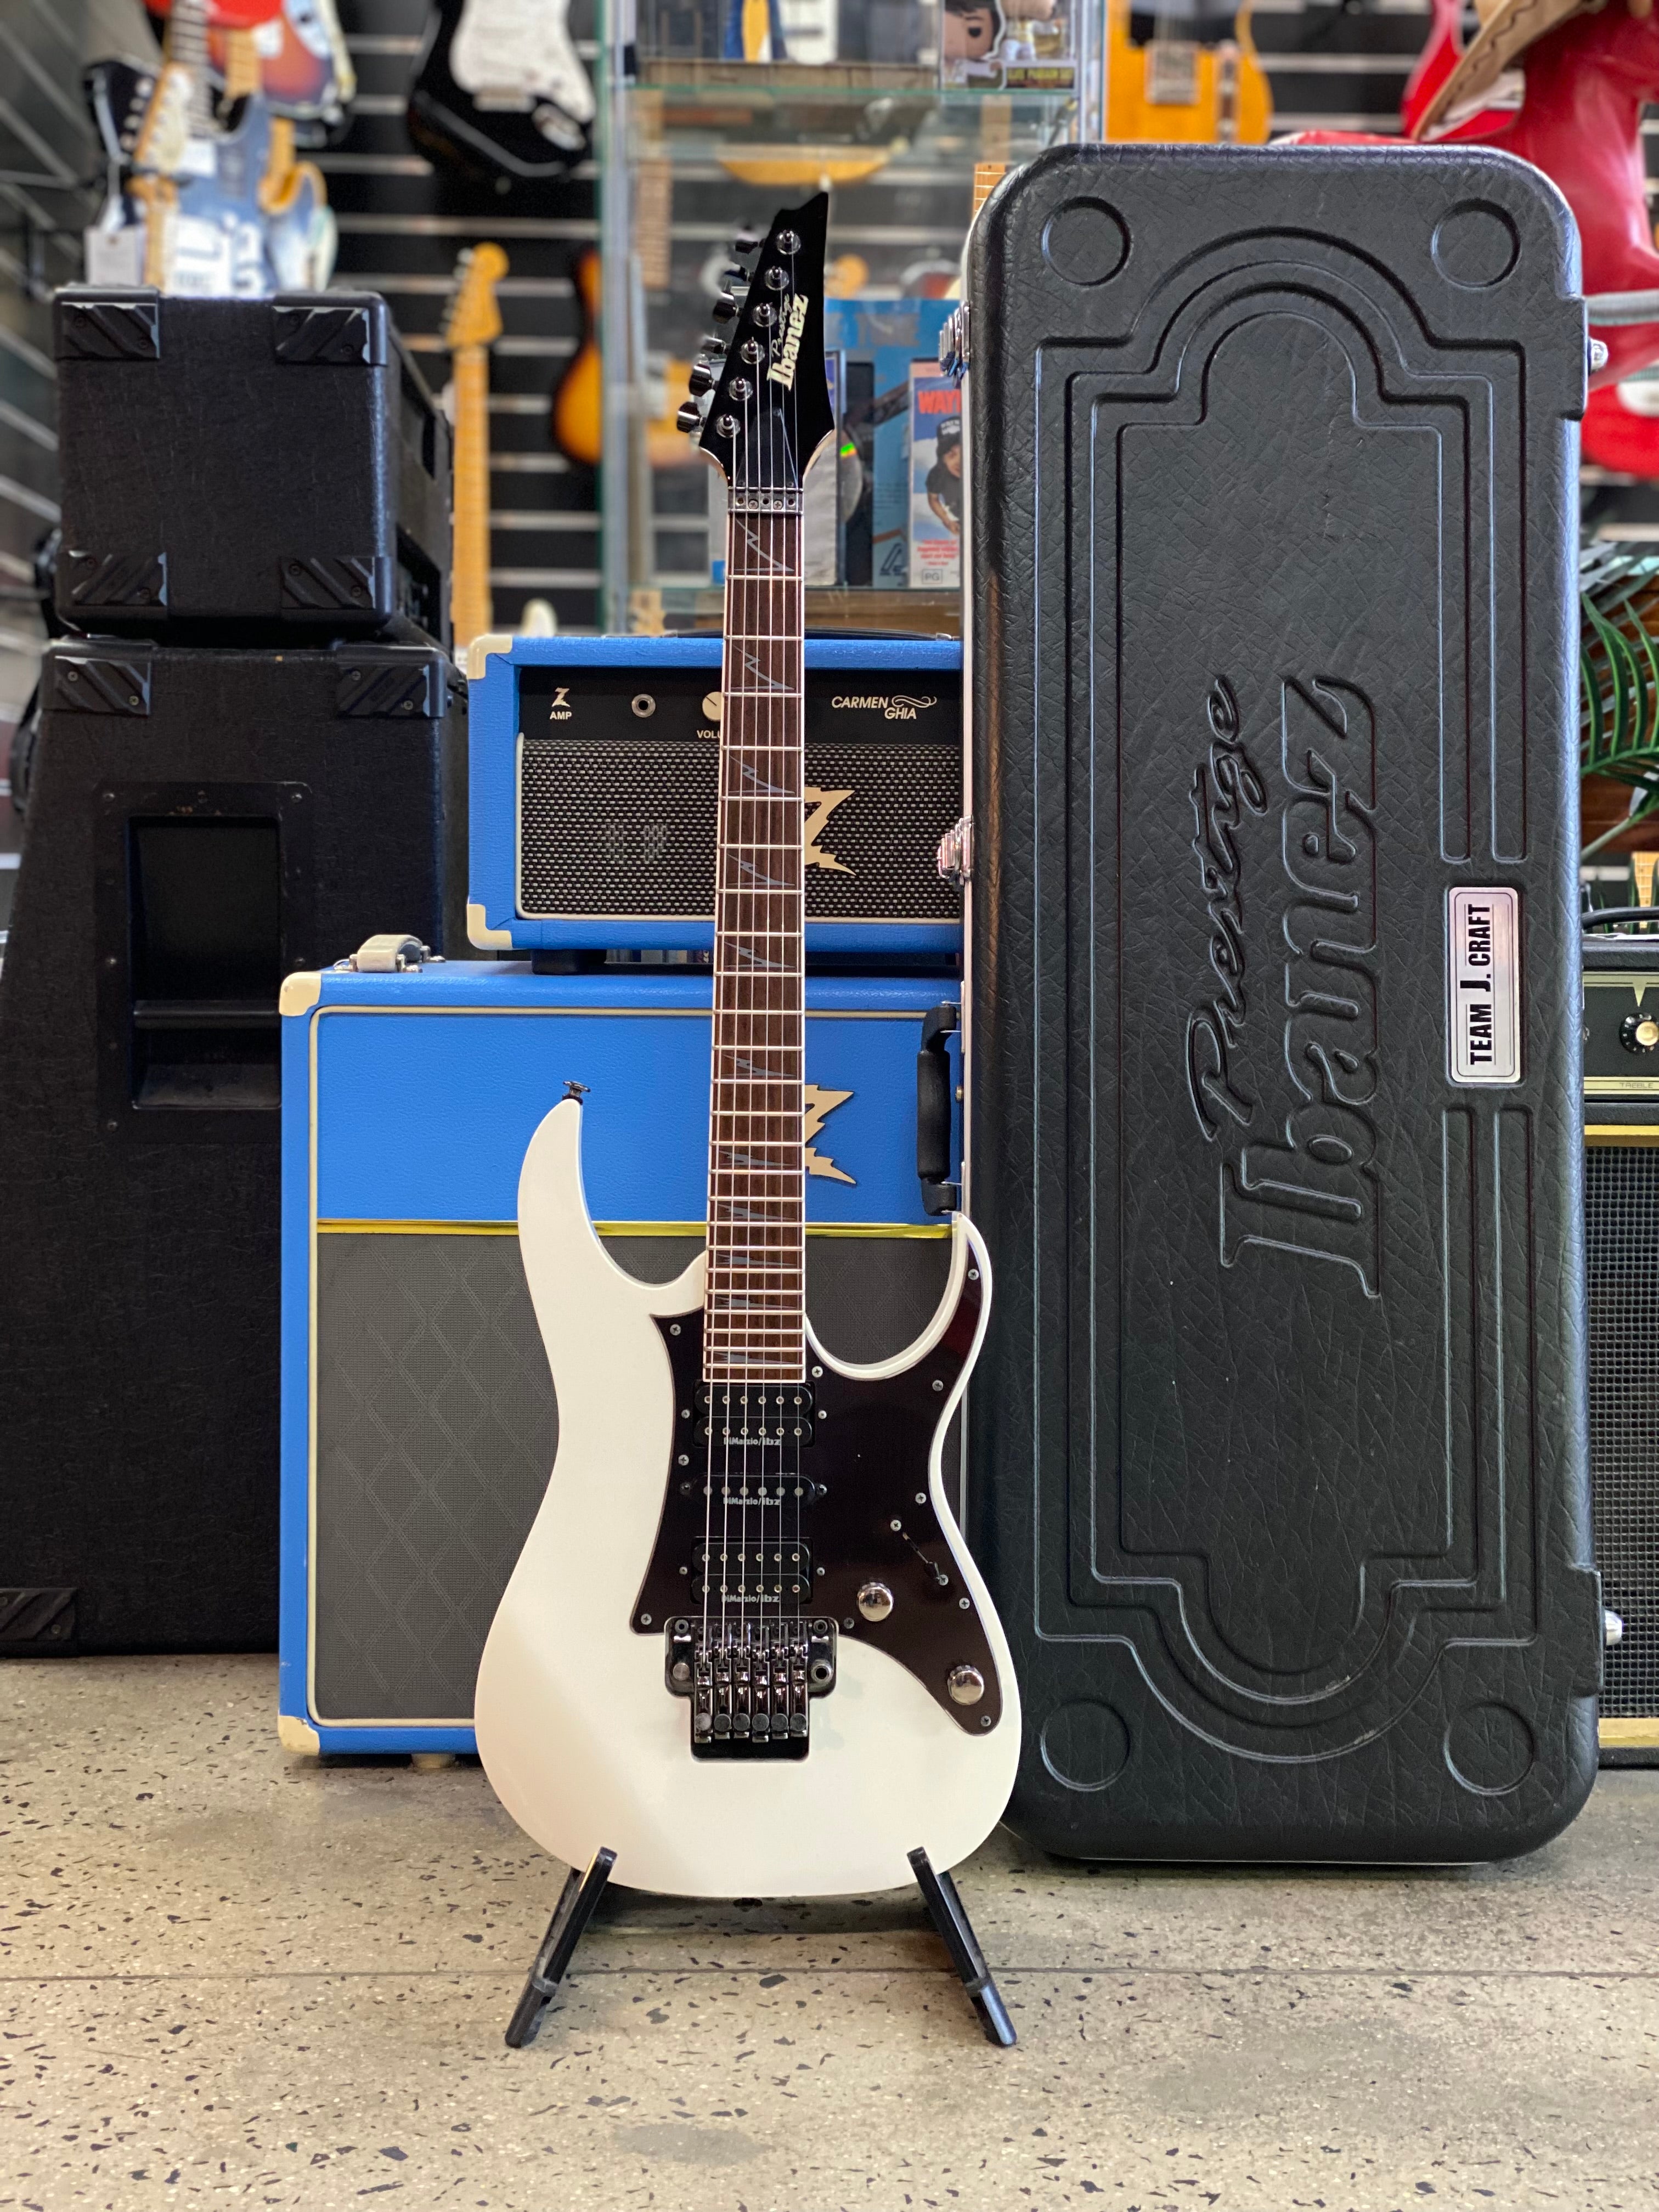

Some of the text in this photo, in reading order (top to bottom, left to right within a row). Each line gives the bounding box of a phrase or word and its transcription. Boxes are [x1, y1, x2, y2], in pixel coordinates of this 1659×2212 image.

[766, 293, 809, 391] Ibanez
[925, 573, 940, 581] PG
[550, 712, 572, 720] AMP
[831, 696, 889, 708] CARMEN
[884, 707, 917, 719] GHIA
[1185, 676, 1266, 1141] Prestige
[1219, 676, 1379, 1299] Ibanez
[1460, 904, 1493, 1065] TEAM J. CRAFT
